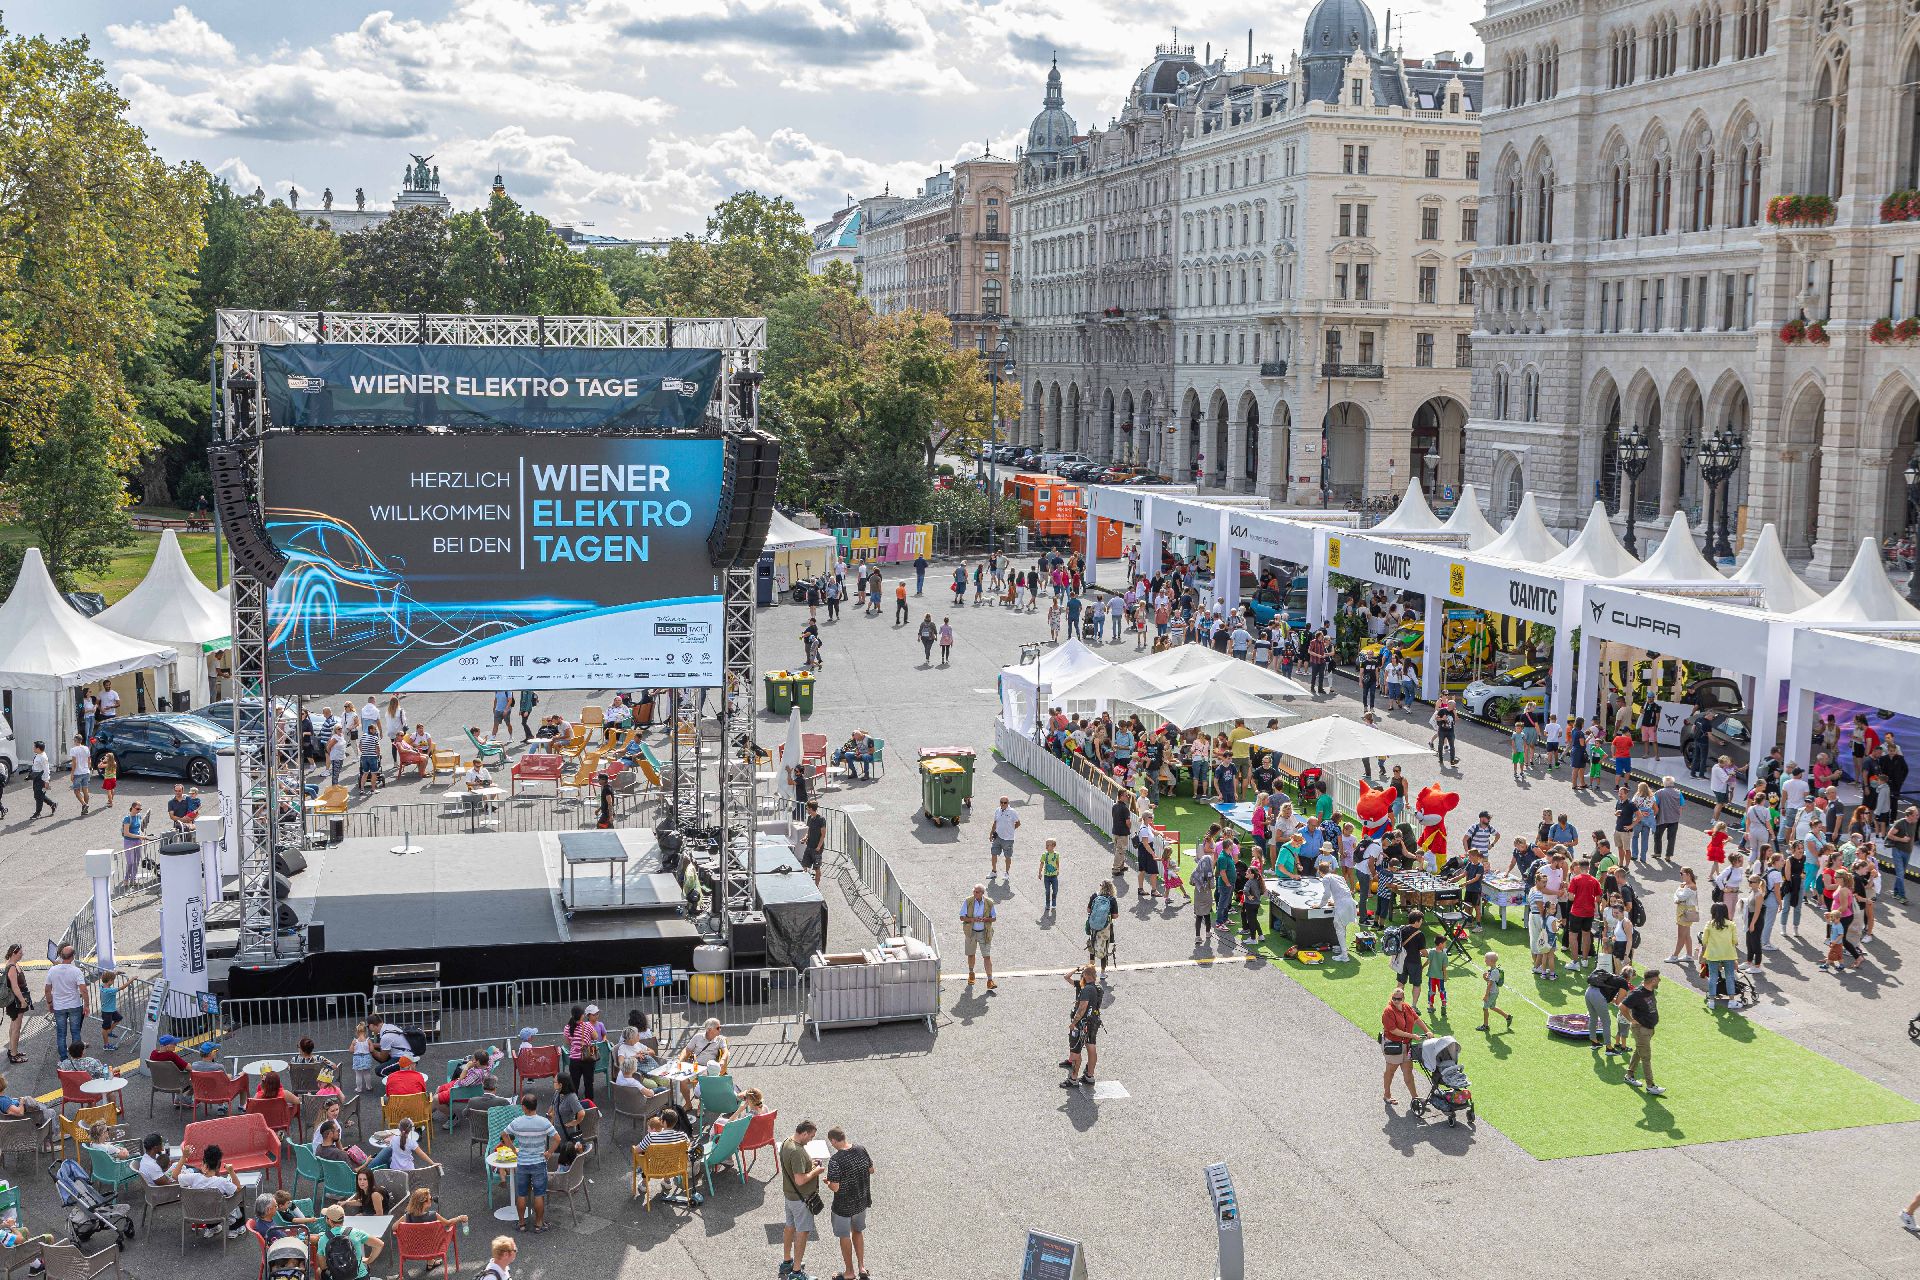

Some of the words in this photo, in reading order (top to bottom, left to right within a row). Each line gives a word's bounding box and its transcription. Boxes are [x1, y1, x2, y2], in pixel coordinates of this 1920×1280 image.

[350, 375, 450, 394] WIENER
[456, 377, 569, 397] ELEKTRO
[575, 378, 638, 397] TAGE
[411, 472, 511, 488] HERZLICH
[532, 464, 670, 492] WIENER
[369, 504, 511, 521] WILLKOMMEN
[533, 500, 692, 527] ELEKTRO
[904, 531, 927, 554] FIAT
[1230, 524, 1248, 538] KIA
[433, 537, 464, 553] BEI
[470, 537, 511, 553] DEN
[533, 535, 649, 562] TAGEN
[1374, 551, 1411, 580] ÖAMTC
[1510, 580, 1557, 615] ÖAMTC
[1611, 610, 1681, 638] CUPRA
[509, 655, 524, 667] FIAT
[193, 930, 202, 968] ELEKTRO
